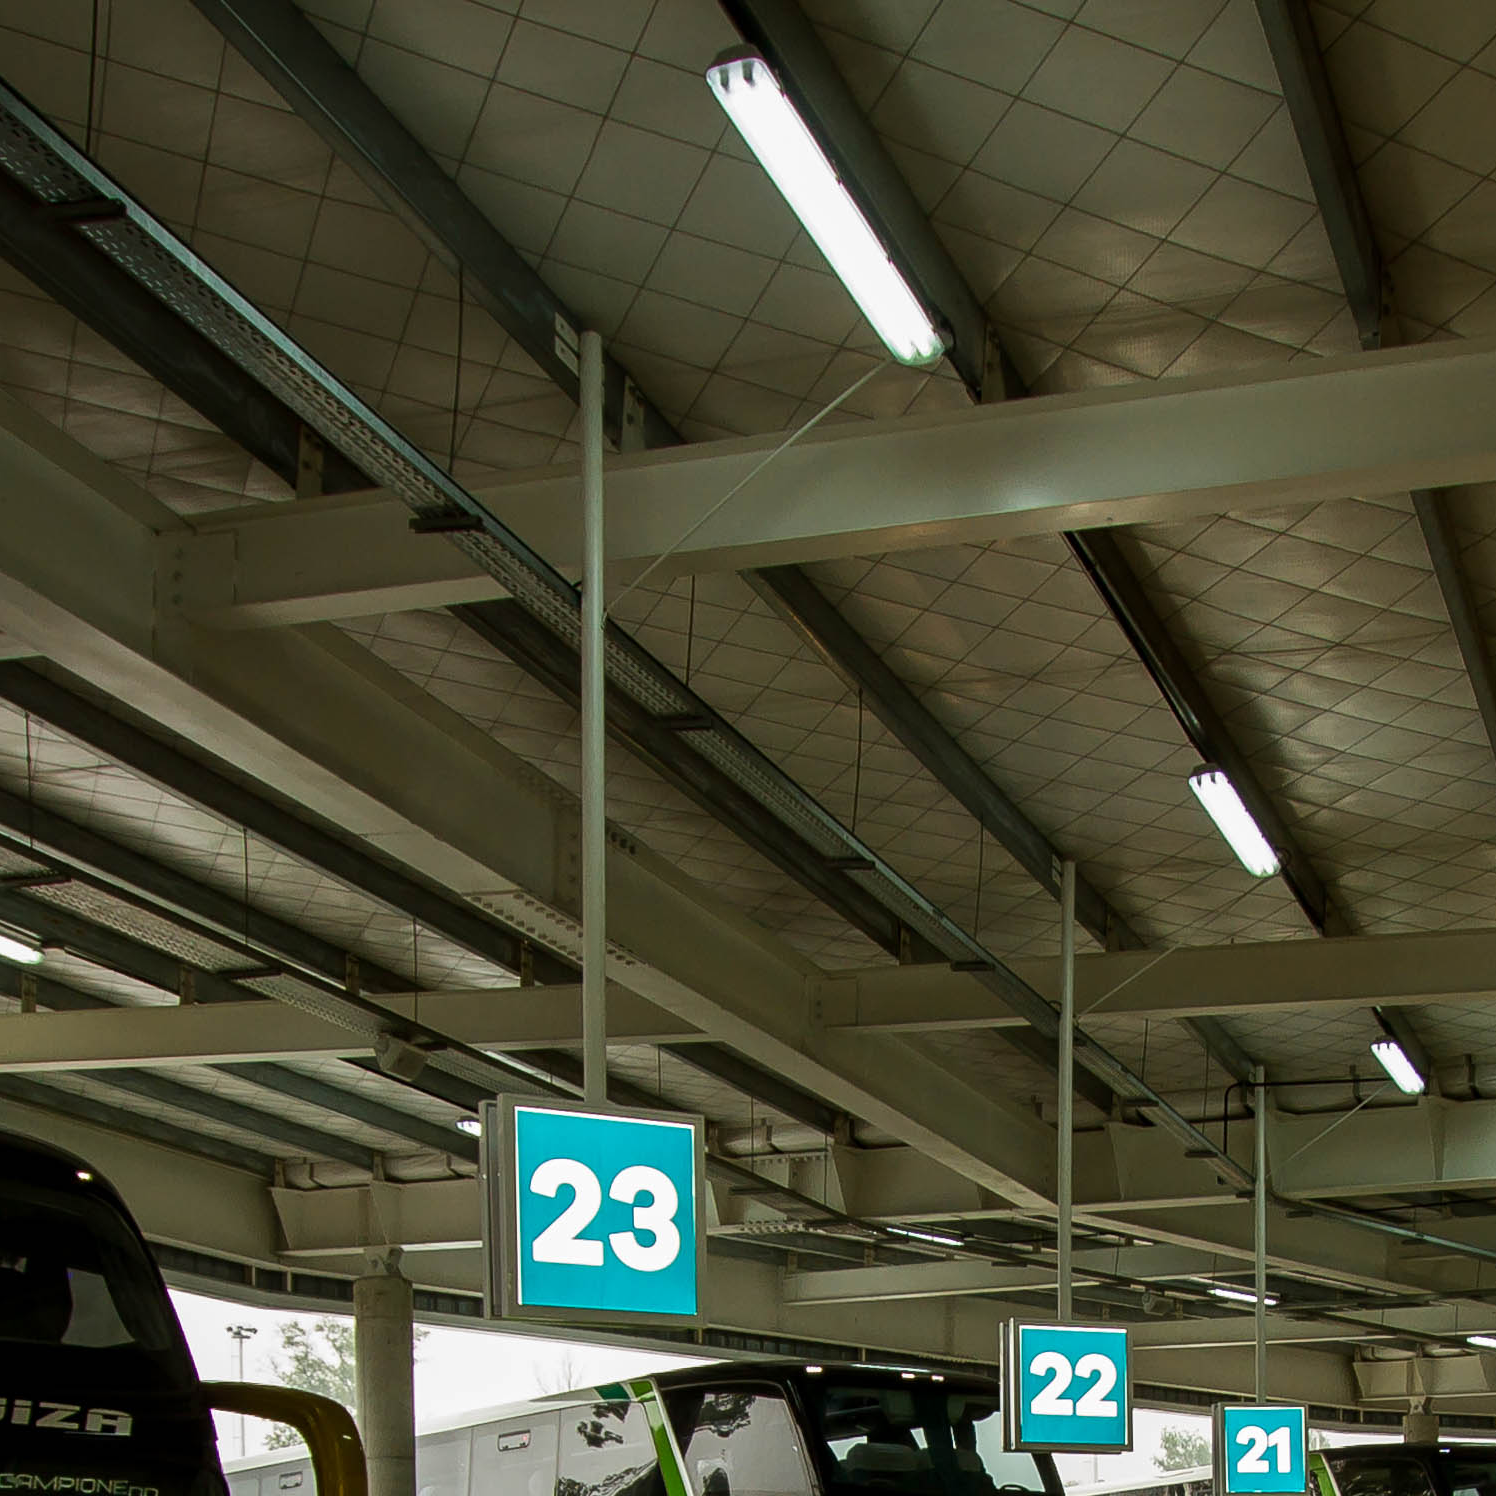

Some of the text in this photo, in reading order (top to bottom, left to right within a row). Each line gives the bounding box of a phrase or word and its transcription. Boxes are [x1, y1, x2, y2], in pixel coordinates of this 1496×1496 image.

[529, 1158, 682, 1273] 23
[1029, 1352, 1119, 1418] 22
[1235, 1426, 1292, 1475] 21
